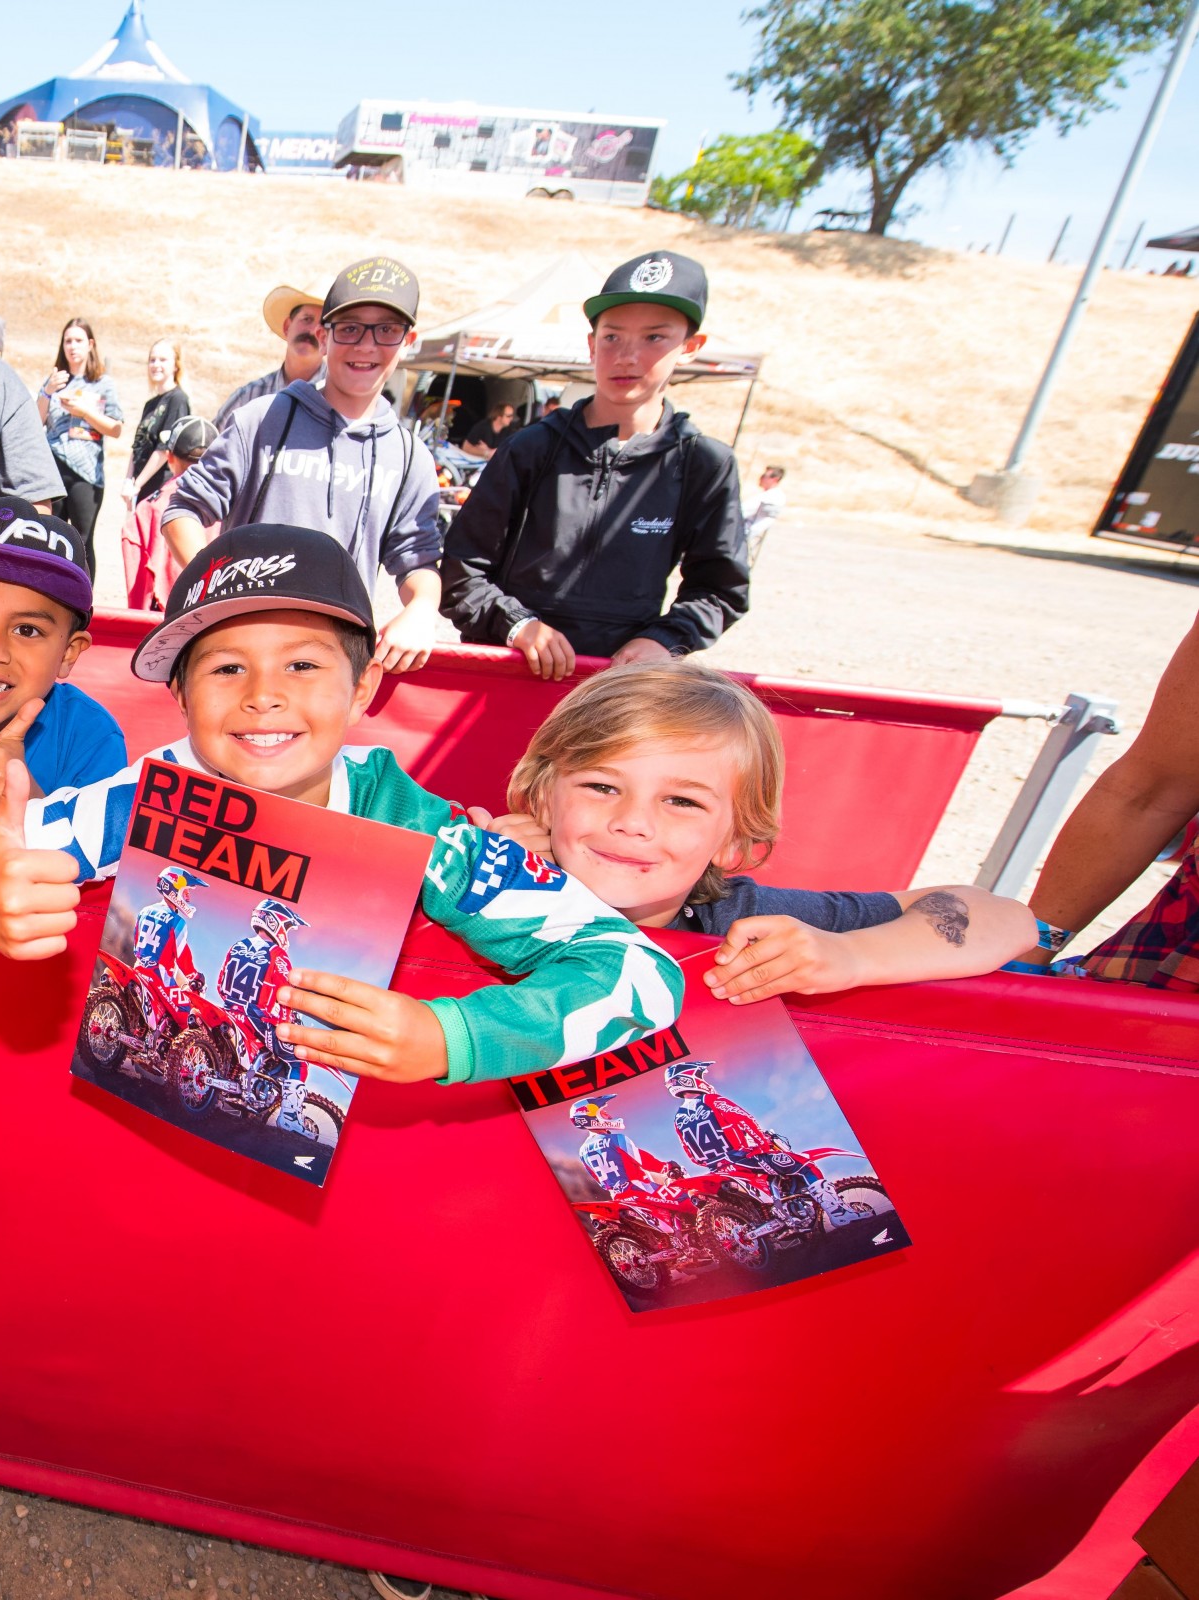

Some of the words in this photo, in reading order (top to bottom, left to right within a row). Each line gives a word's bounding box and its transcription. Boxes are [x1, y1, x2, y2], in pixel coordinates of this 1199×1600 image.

[355, 269, 400, 286] FOX
[209, 578, 276, 598] NISTRY
[143, 764, 258, 834] RED
[139, 807, 304, 900] TEAM
[222, 957, 261, 1005] 14
[513, 1030, 684, 1106] TEAM
[682, 1119, 730, 1161] 14
